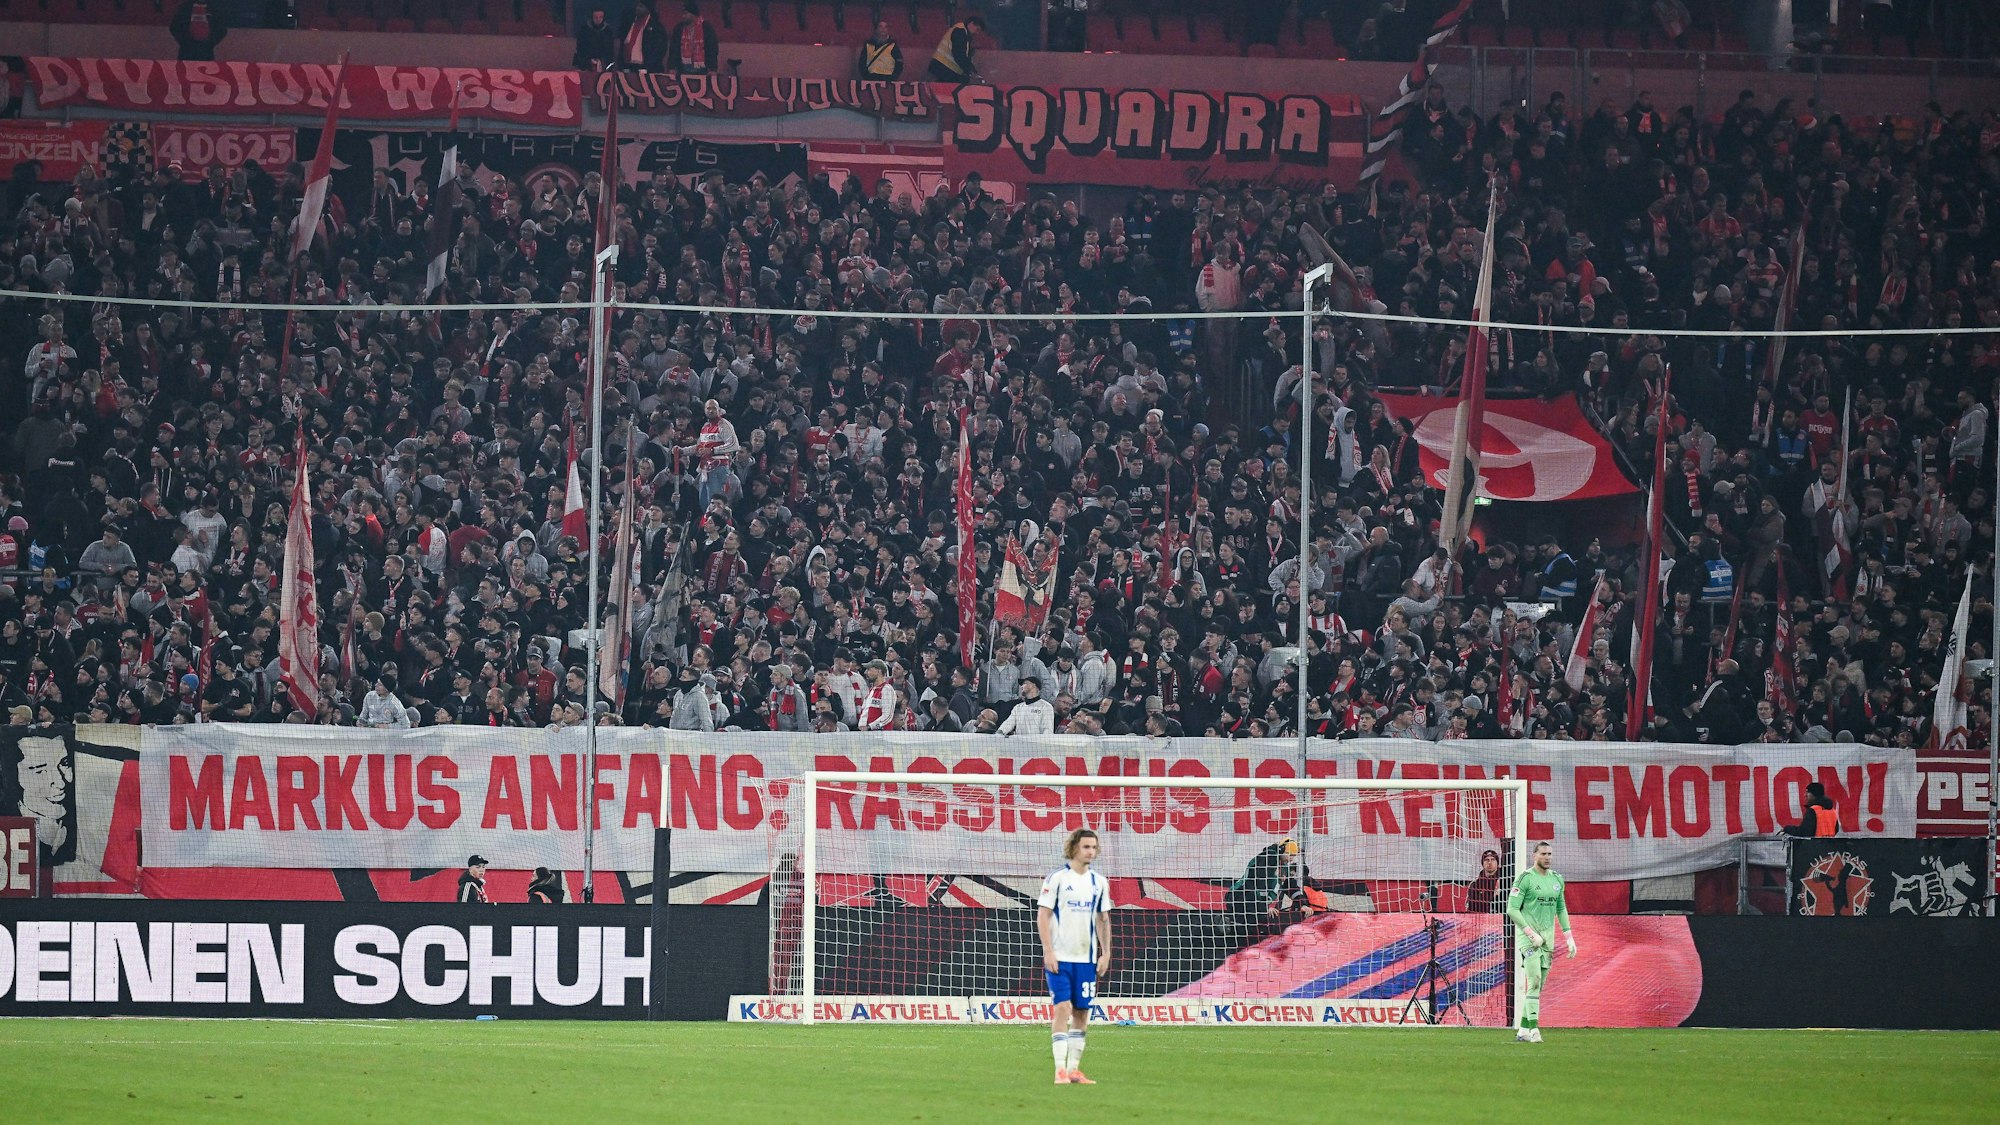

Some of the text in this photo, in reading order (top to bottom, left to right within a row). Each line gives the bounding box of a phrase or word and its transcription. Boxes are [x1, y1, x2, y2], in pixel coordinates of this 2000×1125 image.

[29, 57, 581, 119] DIVISION WEST
[772, 77, 927, 115] YOUTH
[955, 86, 1329, 169] SQUADRA
[158, 131, 292, 166] 40625
[169, 753, 1888, 840] MARKUS ANFANG: RASSISMUS IST KEINE EMOTION!
[1809, 851, 1868, 871] ULTRAS
[333, 924, 651, 1006] SCHUH
[1081, 981, 1096, 998] 35
[740, 1000, 1425, 1024] KÜCHEN AKTUELL KÜCH AKTUELL KÜCHEN AKTUELL
